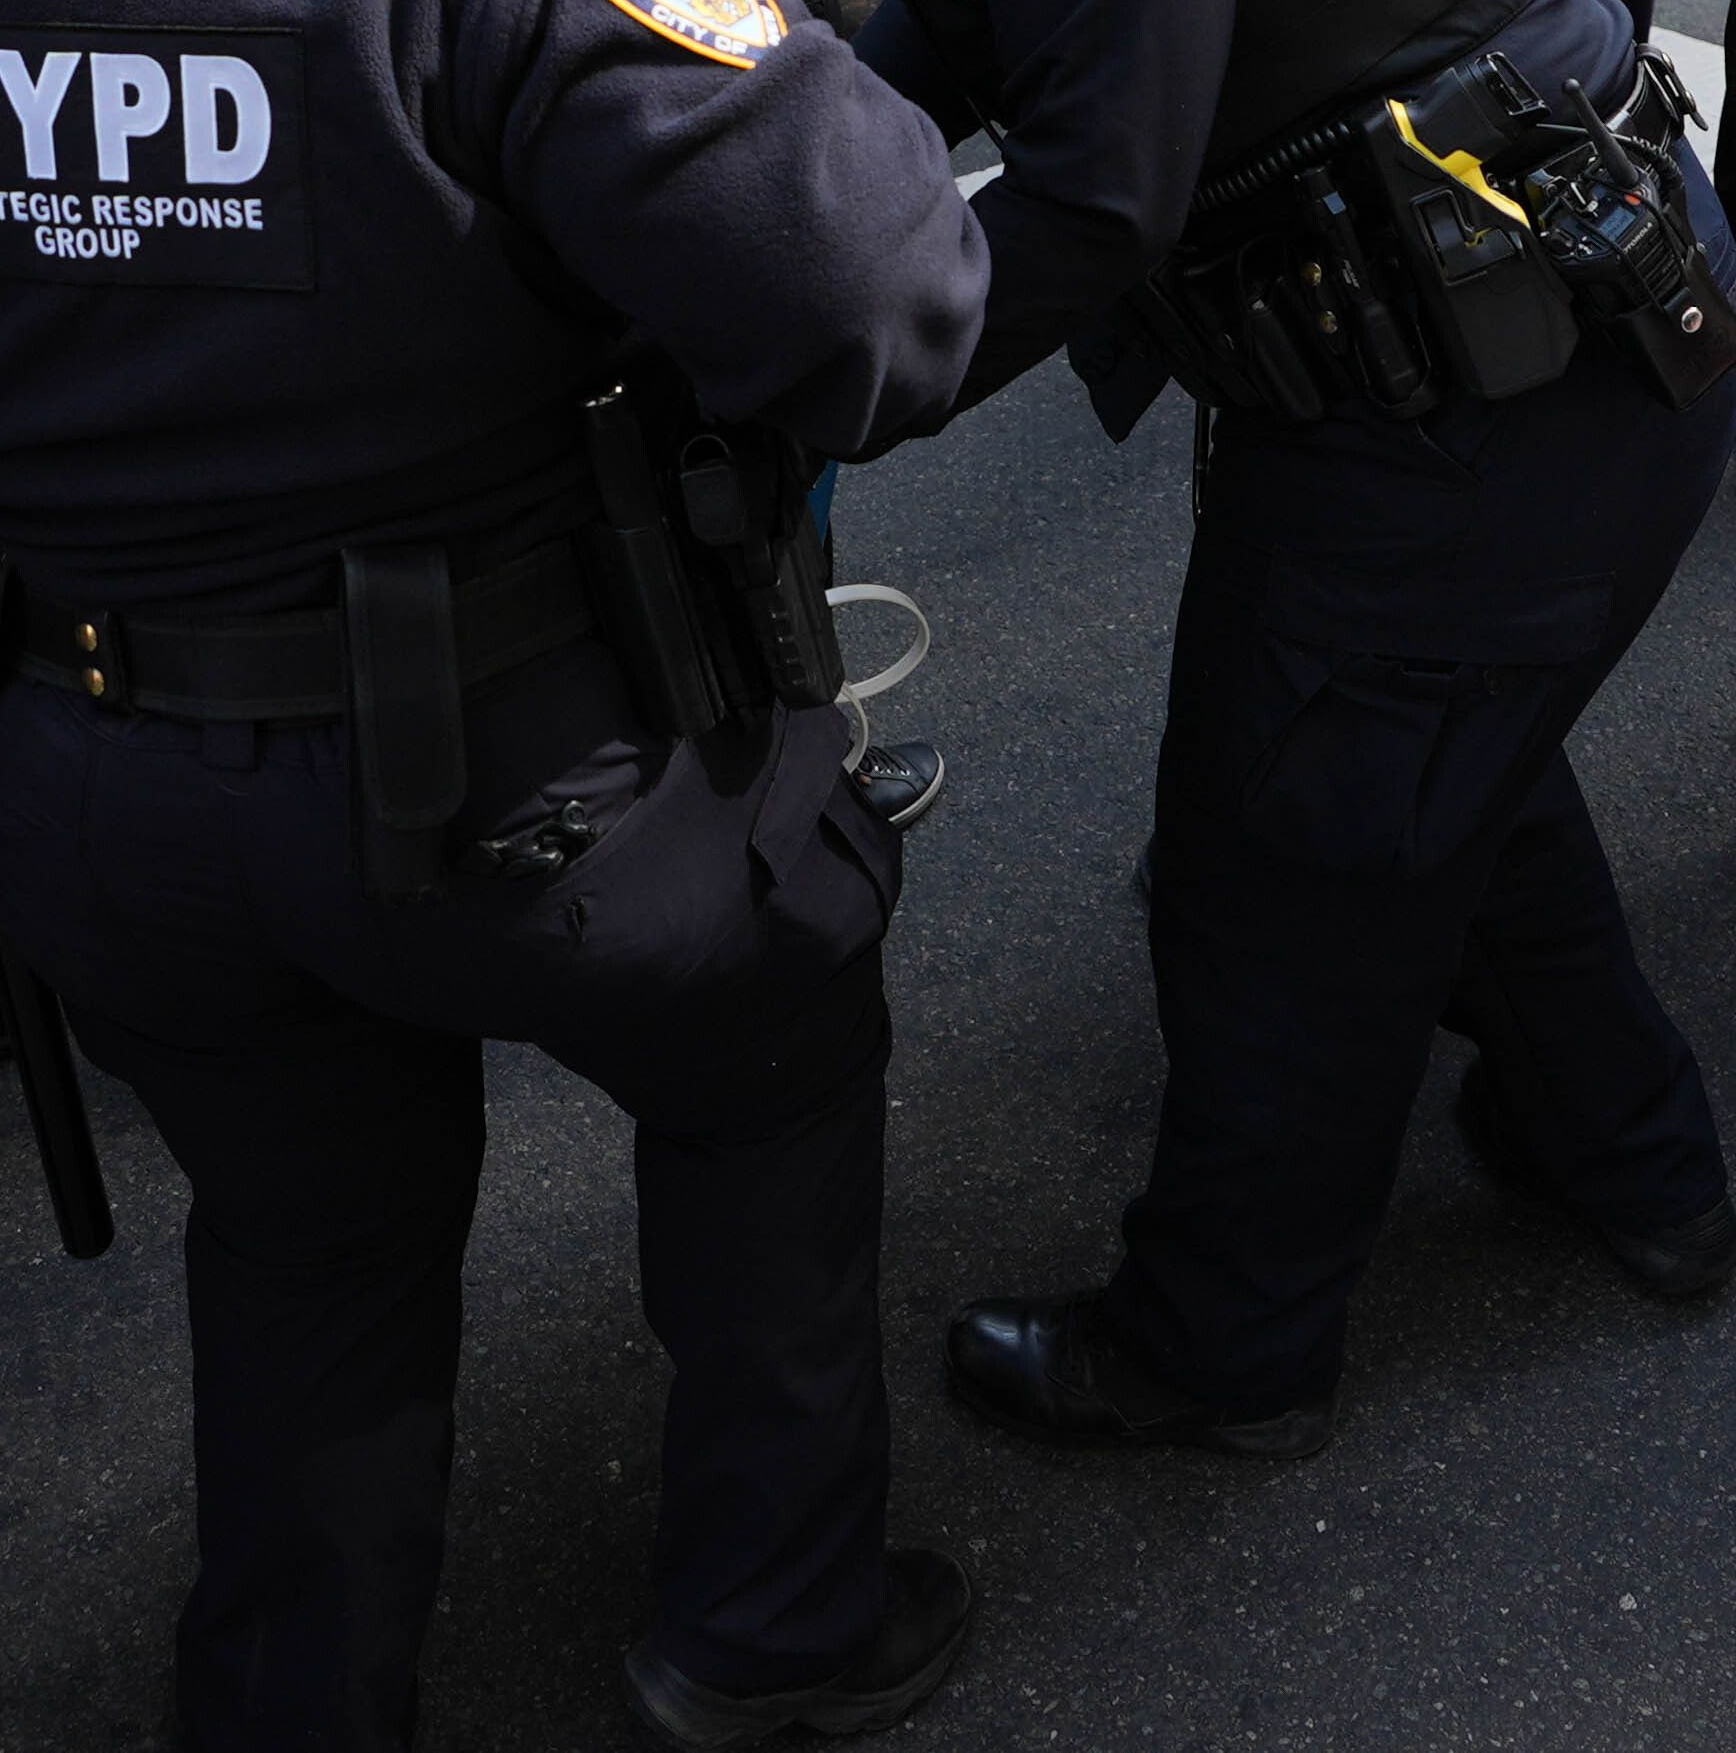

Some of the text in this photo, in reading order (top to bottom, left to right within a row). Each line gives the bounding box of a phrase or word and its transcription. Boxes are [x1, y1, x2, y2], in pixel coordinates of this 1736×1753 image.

[651, 3, 749, 55] CITY OF
[92, 195, 264, 231] RESPONSE
[34, 225, 141, 259] GROUP
